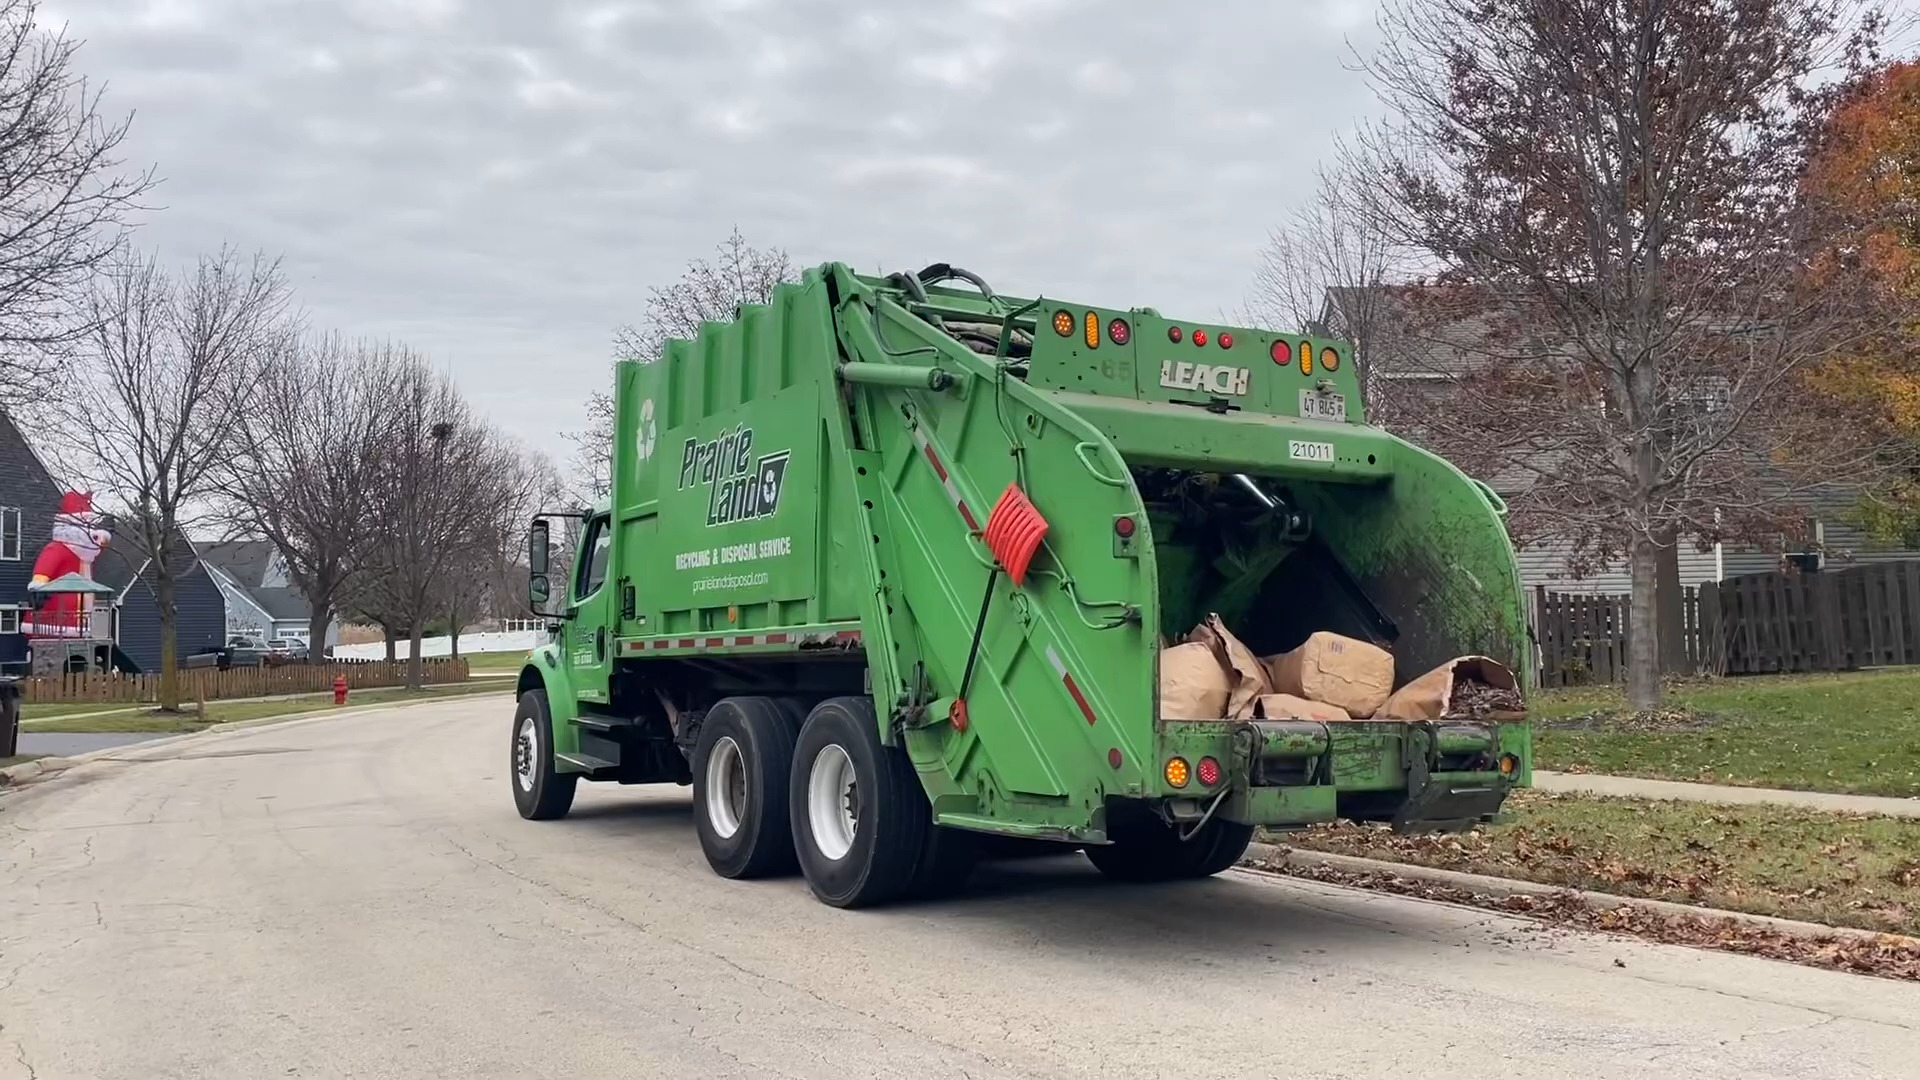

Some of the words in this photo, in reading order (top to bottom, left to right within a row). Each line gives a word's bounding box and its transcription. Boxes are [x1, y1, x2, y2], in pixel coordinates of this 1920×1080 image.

[1160, 359, 1250, 397] LEACH
[1304, 397, 1315, 414] 47
[1318, 399, 1336, 416] 845
[677, 422, 754, 491] Prairie
[1292, 441, 1331, 459] 21011
[705, 460, 762, 528] Land
[676, 550, 710, 571] RECYCLING
[712, 547, 719, 565] &
[721, 543, 757, 564] DISPOSAL
[759, 536, 791, 559] SERVICE
